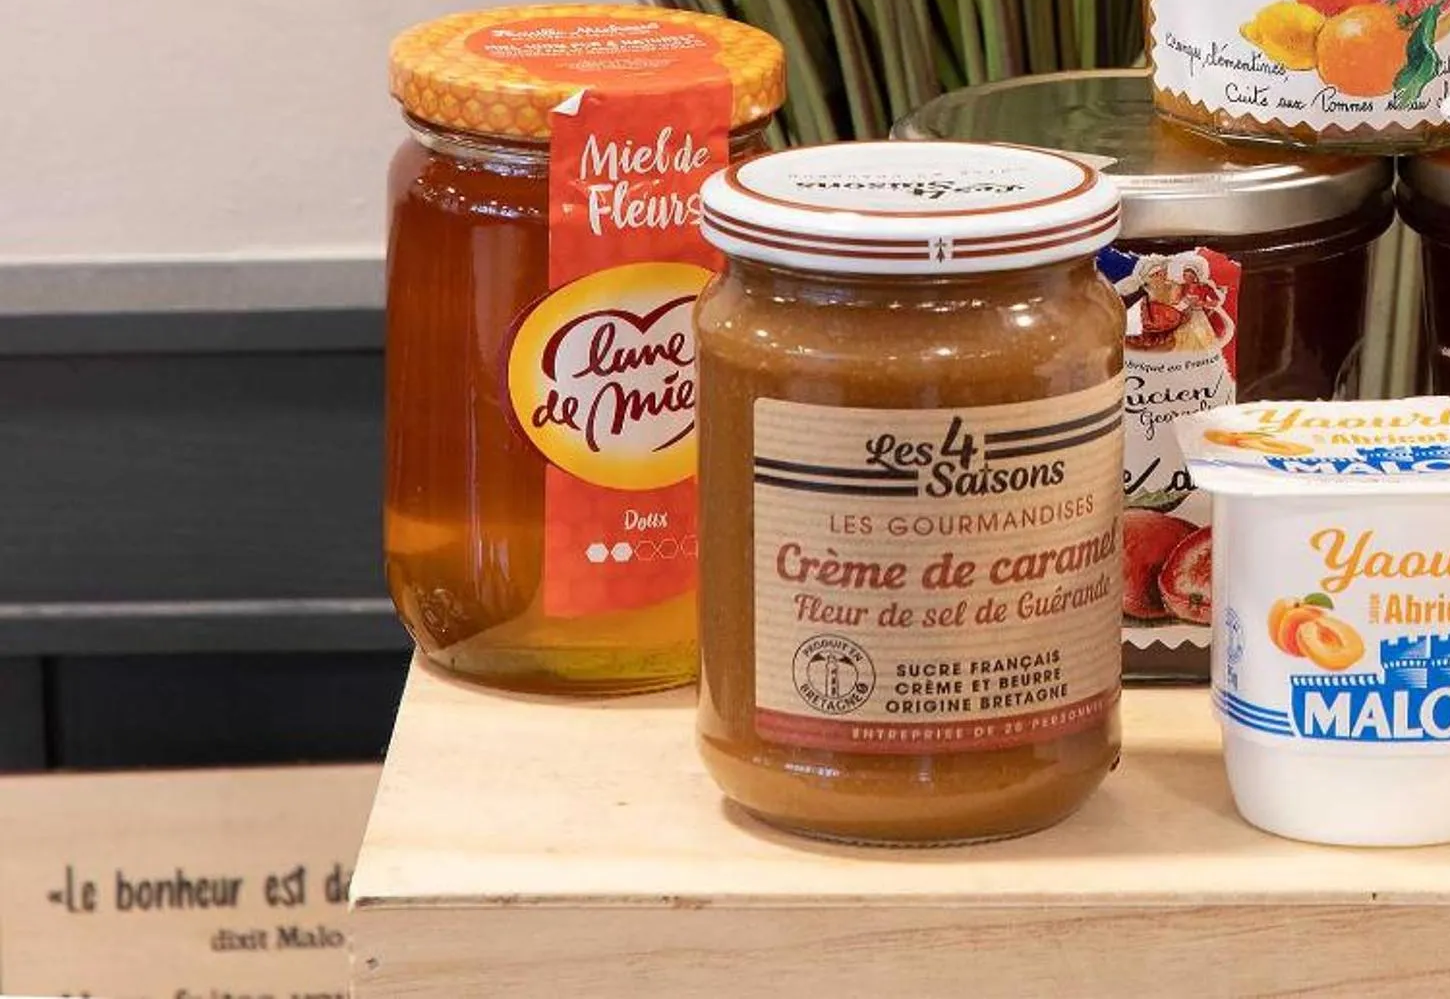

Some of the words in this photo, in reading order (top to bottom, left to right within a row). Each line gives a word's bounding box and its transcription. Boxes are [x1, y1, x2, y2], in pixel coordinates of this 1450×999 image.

[1311, 87, 1373, 113] Pommes
[580, 126, 674, 181] Miel
[675, 134, 711, 173] de
[587, 177, 703, 236] Fleurs
[1125, 359, 1165, 374] briqué
[533, 390, 583, 430] de
[865, 433, 934, 472] Les
[940, 416, 979, 469] 4
[925, 459, 1066, 499] Saisons
[624, 509, 669, 532] Doux
[830, 515, 874, 534] LES
[888, 495, 1095, 536] GOURMANDISES
[776, 541, 908, 591] Crème
[921, 552, 976, 590] de
[989, 517, 1121, 577] caramel
[793, 594, 869, 627] Fleur
[878, 601, 914, 628] de
[922, 598, 965, 629] sel
[974, 594, 1008, 624] de
[1017, 576, 1113, 620] Guérande
[895, 677, 963, 696] CRÈME
[972, 679, 990, 693] ET
[999, 668, 1062, 690] BEURRE
[896, 662, 962, 678] SUCRE
[970, 649, 1061, 676] FRANÇAIS
[885, 698, 972, 714] ORIGINE
[980, 683, 1069, 711] BRETAGNE
[115, 867, 242, 911] bonheur
[264, 864, 305, 906] est
[210, 929, 267, 951] dixit
[277, 925, 344, 950] Malo
